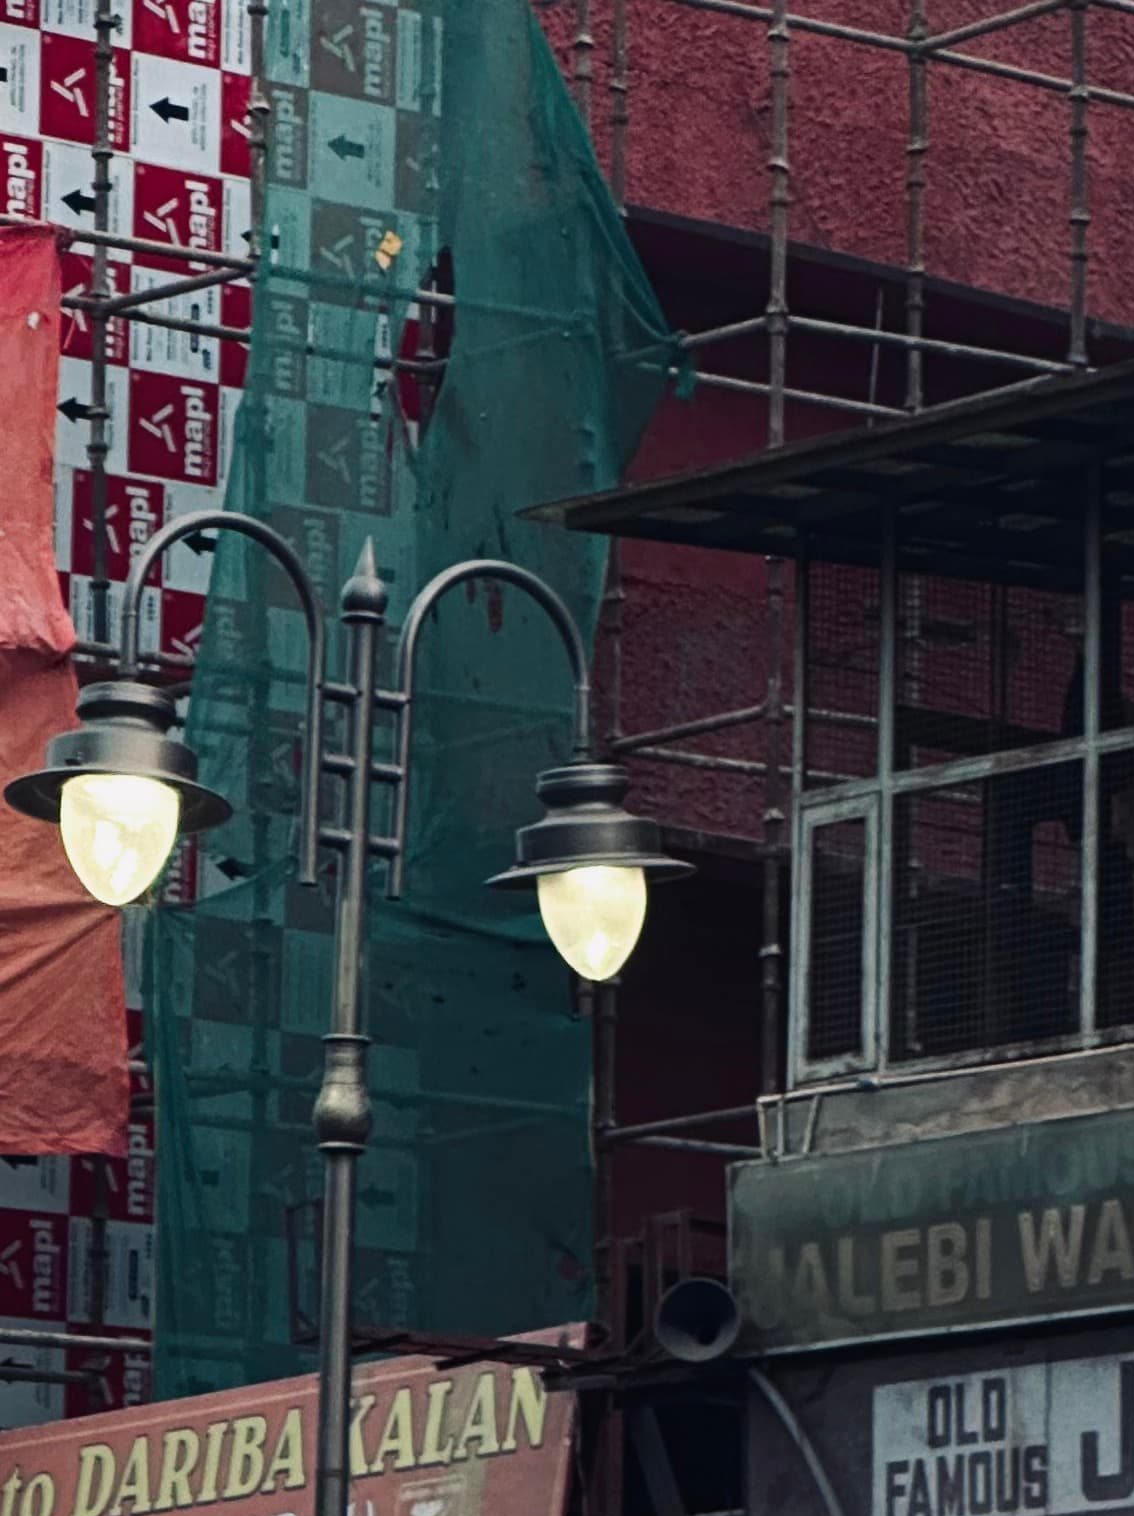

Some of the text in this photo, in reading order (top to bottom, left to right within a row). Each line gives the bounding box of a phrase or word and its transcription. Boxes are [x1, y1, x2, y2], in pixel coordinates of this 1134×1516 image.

[180, 384, 213, 478] mapl
[127, 1123, 154, 1216] mapl
[29, 1218, 60, 1312] mapl
[743, 1216, 994, 1329] JALEBI
[926, 1376, 1007, 1450] OLD
